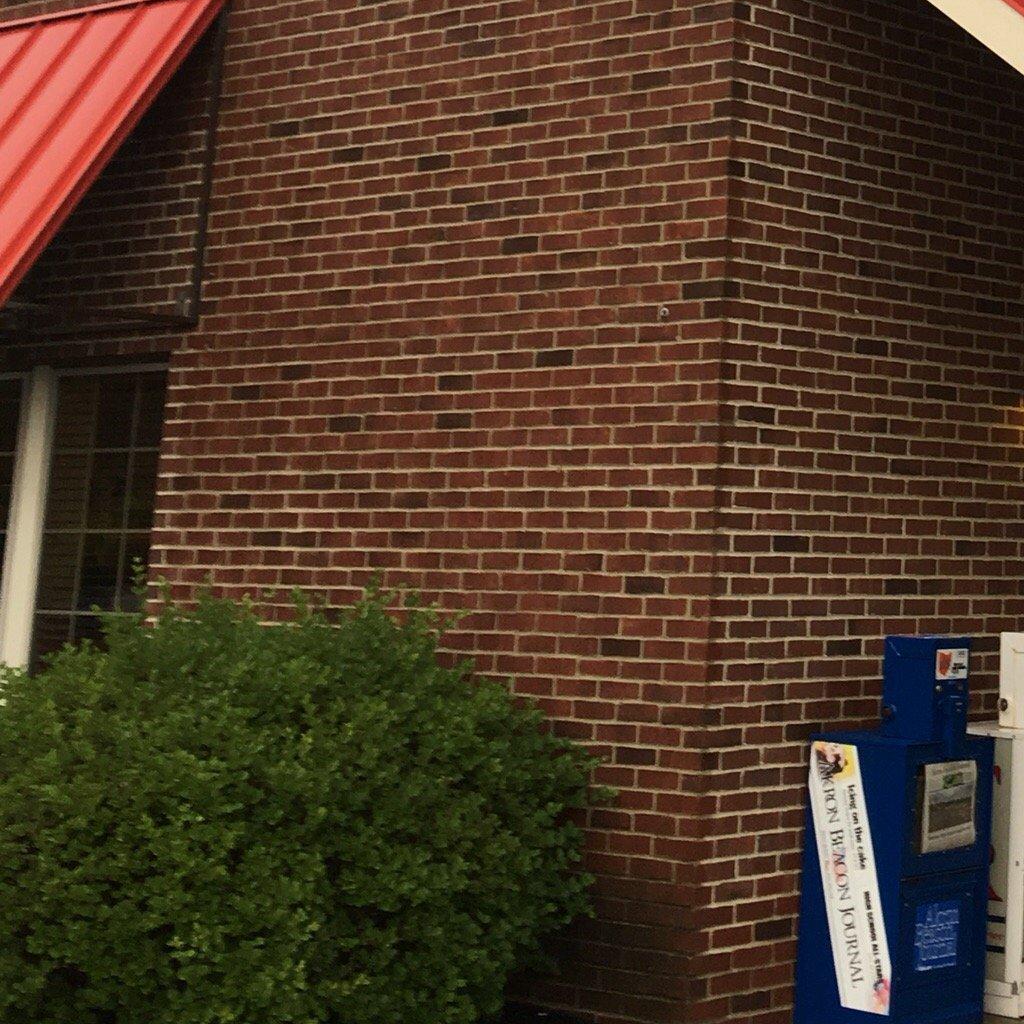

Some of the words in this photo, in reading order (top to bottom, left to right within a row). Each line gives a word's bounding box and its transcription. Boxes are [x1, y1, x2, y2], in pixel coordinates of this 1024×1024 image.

[819, 761, 840, 823] AKRON
[847, 784, 858, 809] Icing
[851, 812, 859, 824] on
[854, 826, 863, 843] the
[830, 830, 851, 900] BEACON
[857, 846, 866, 869] cake
[838, 907, 864, 988] JOURNAL
